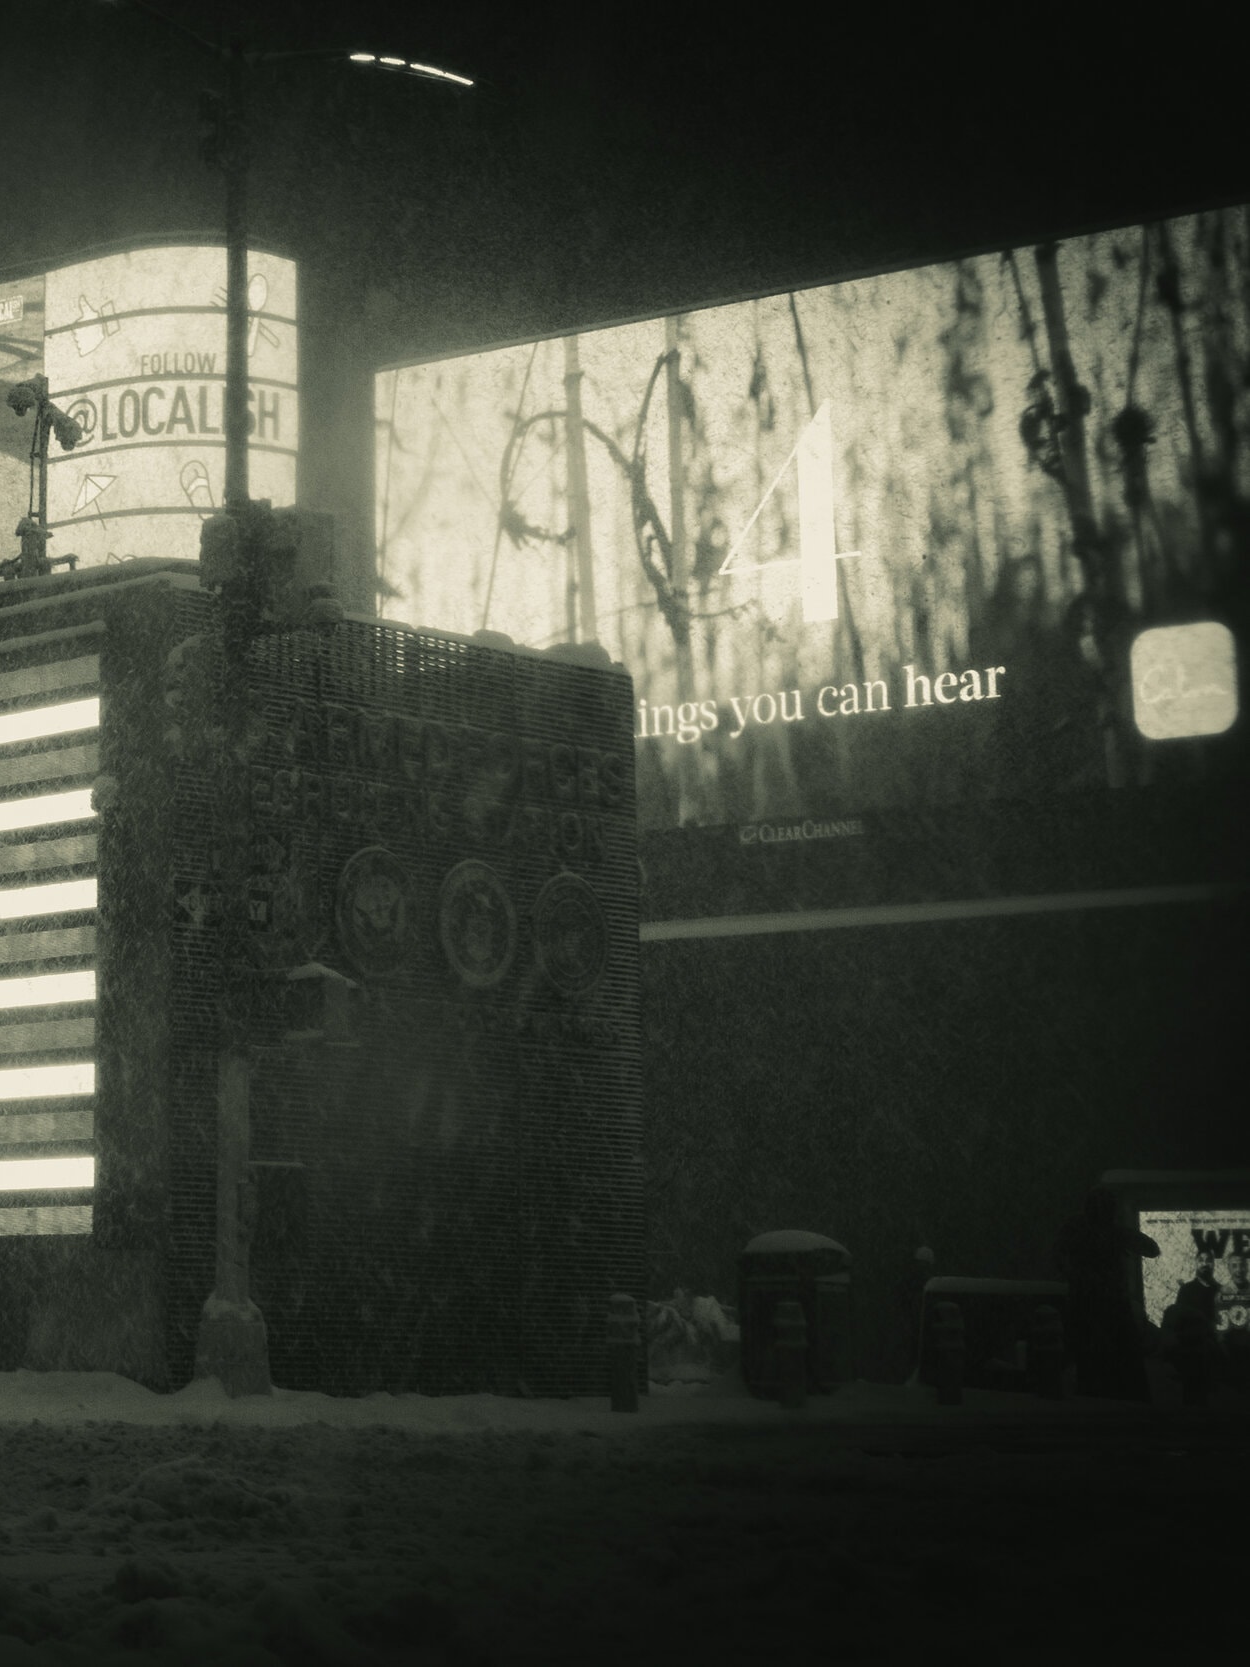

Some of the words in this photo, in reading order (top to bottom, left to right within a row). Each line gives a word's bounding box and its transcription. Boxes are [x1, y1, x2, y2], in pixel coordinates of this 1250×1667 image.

[141, 352, 216, 376] FOLLOW
[719, 398, 862, 622] 4
[634, 697, 718, 744] ings
[730, 687, 805, 738] you
[818, 678, 892, 716] can
[903, 664, 1006, 708] hear
